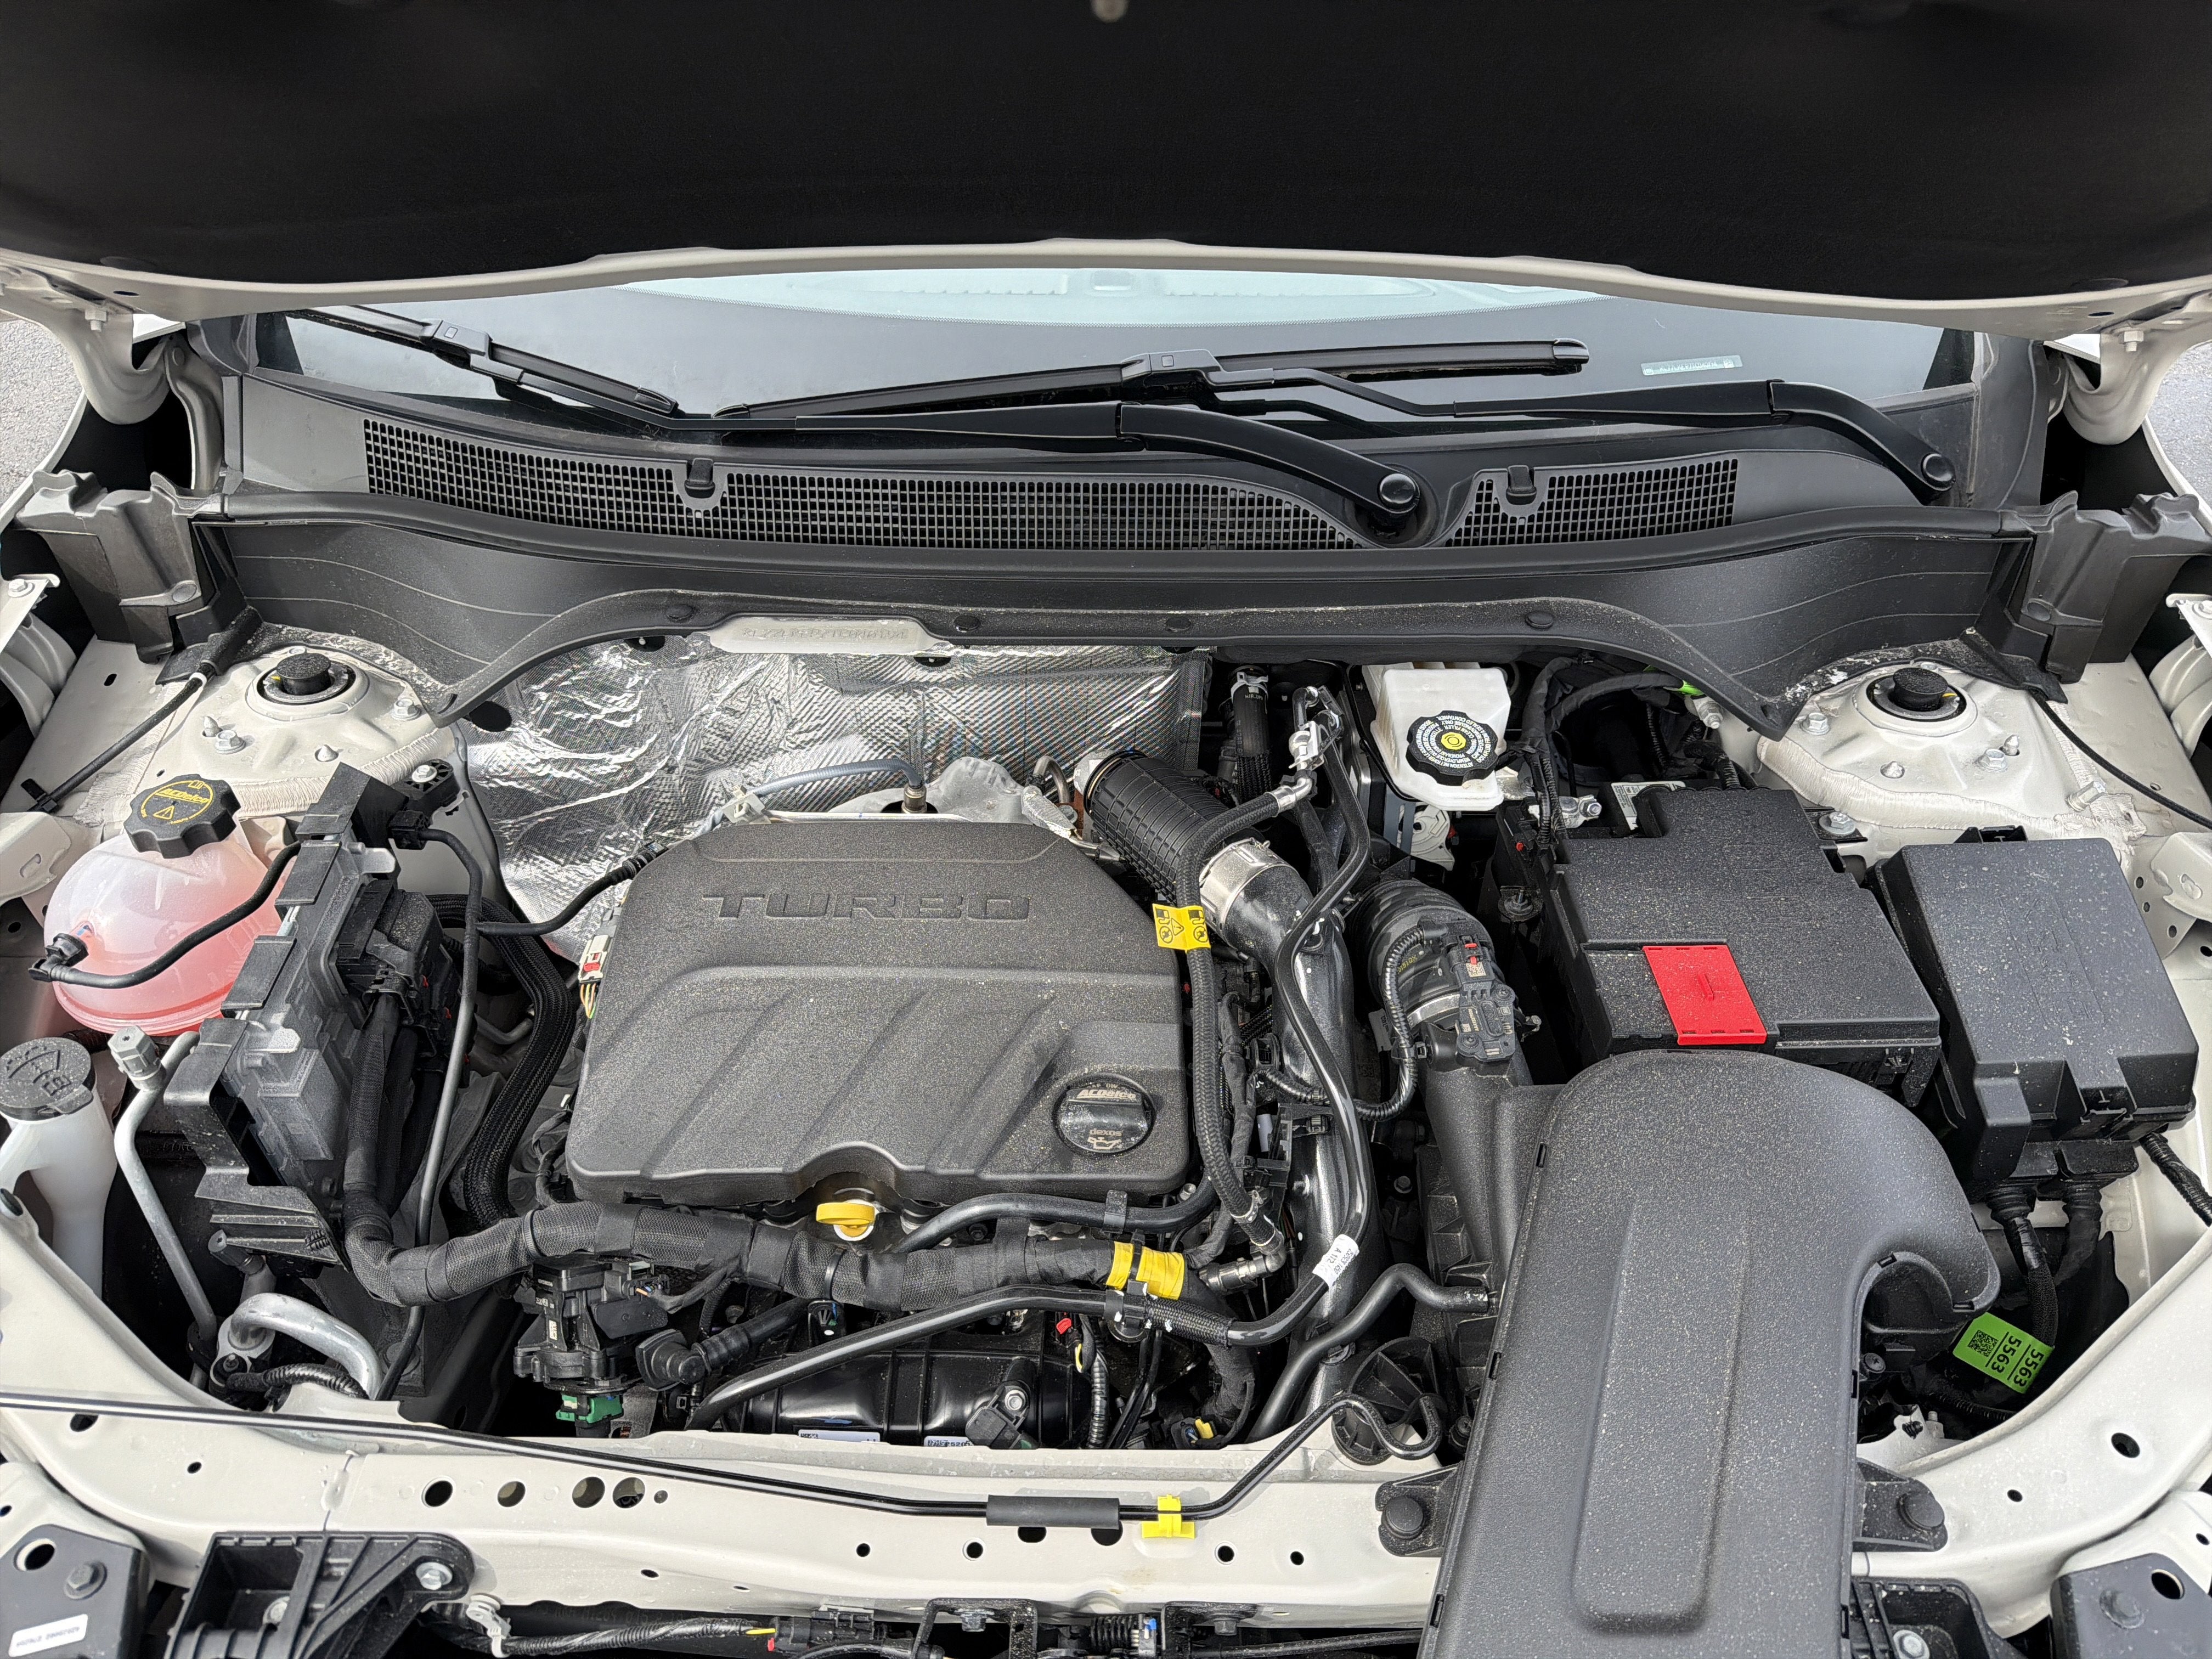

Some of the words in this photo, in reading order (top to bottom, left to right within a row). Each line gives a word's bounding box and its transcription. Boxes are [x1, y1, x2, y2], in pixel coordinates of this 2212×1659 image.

[159, 788, 210, 803] ACDelco
[703, 894, 1029, 921] TURBO
[1077, 1089, 1137, 1099] ACDelco
[1089, 1128, 1122, 1136] dexos
[1991, 1335, 2022, 1373] 5563
[2013, 1348, 2045, 1387] 5563
